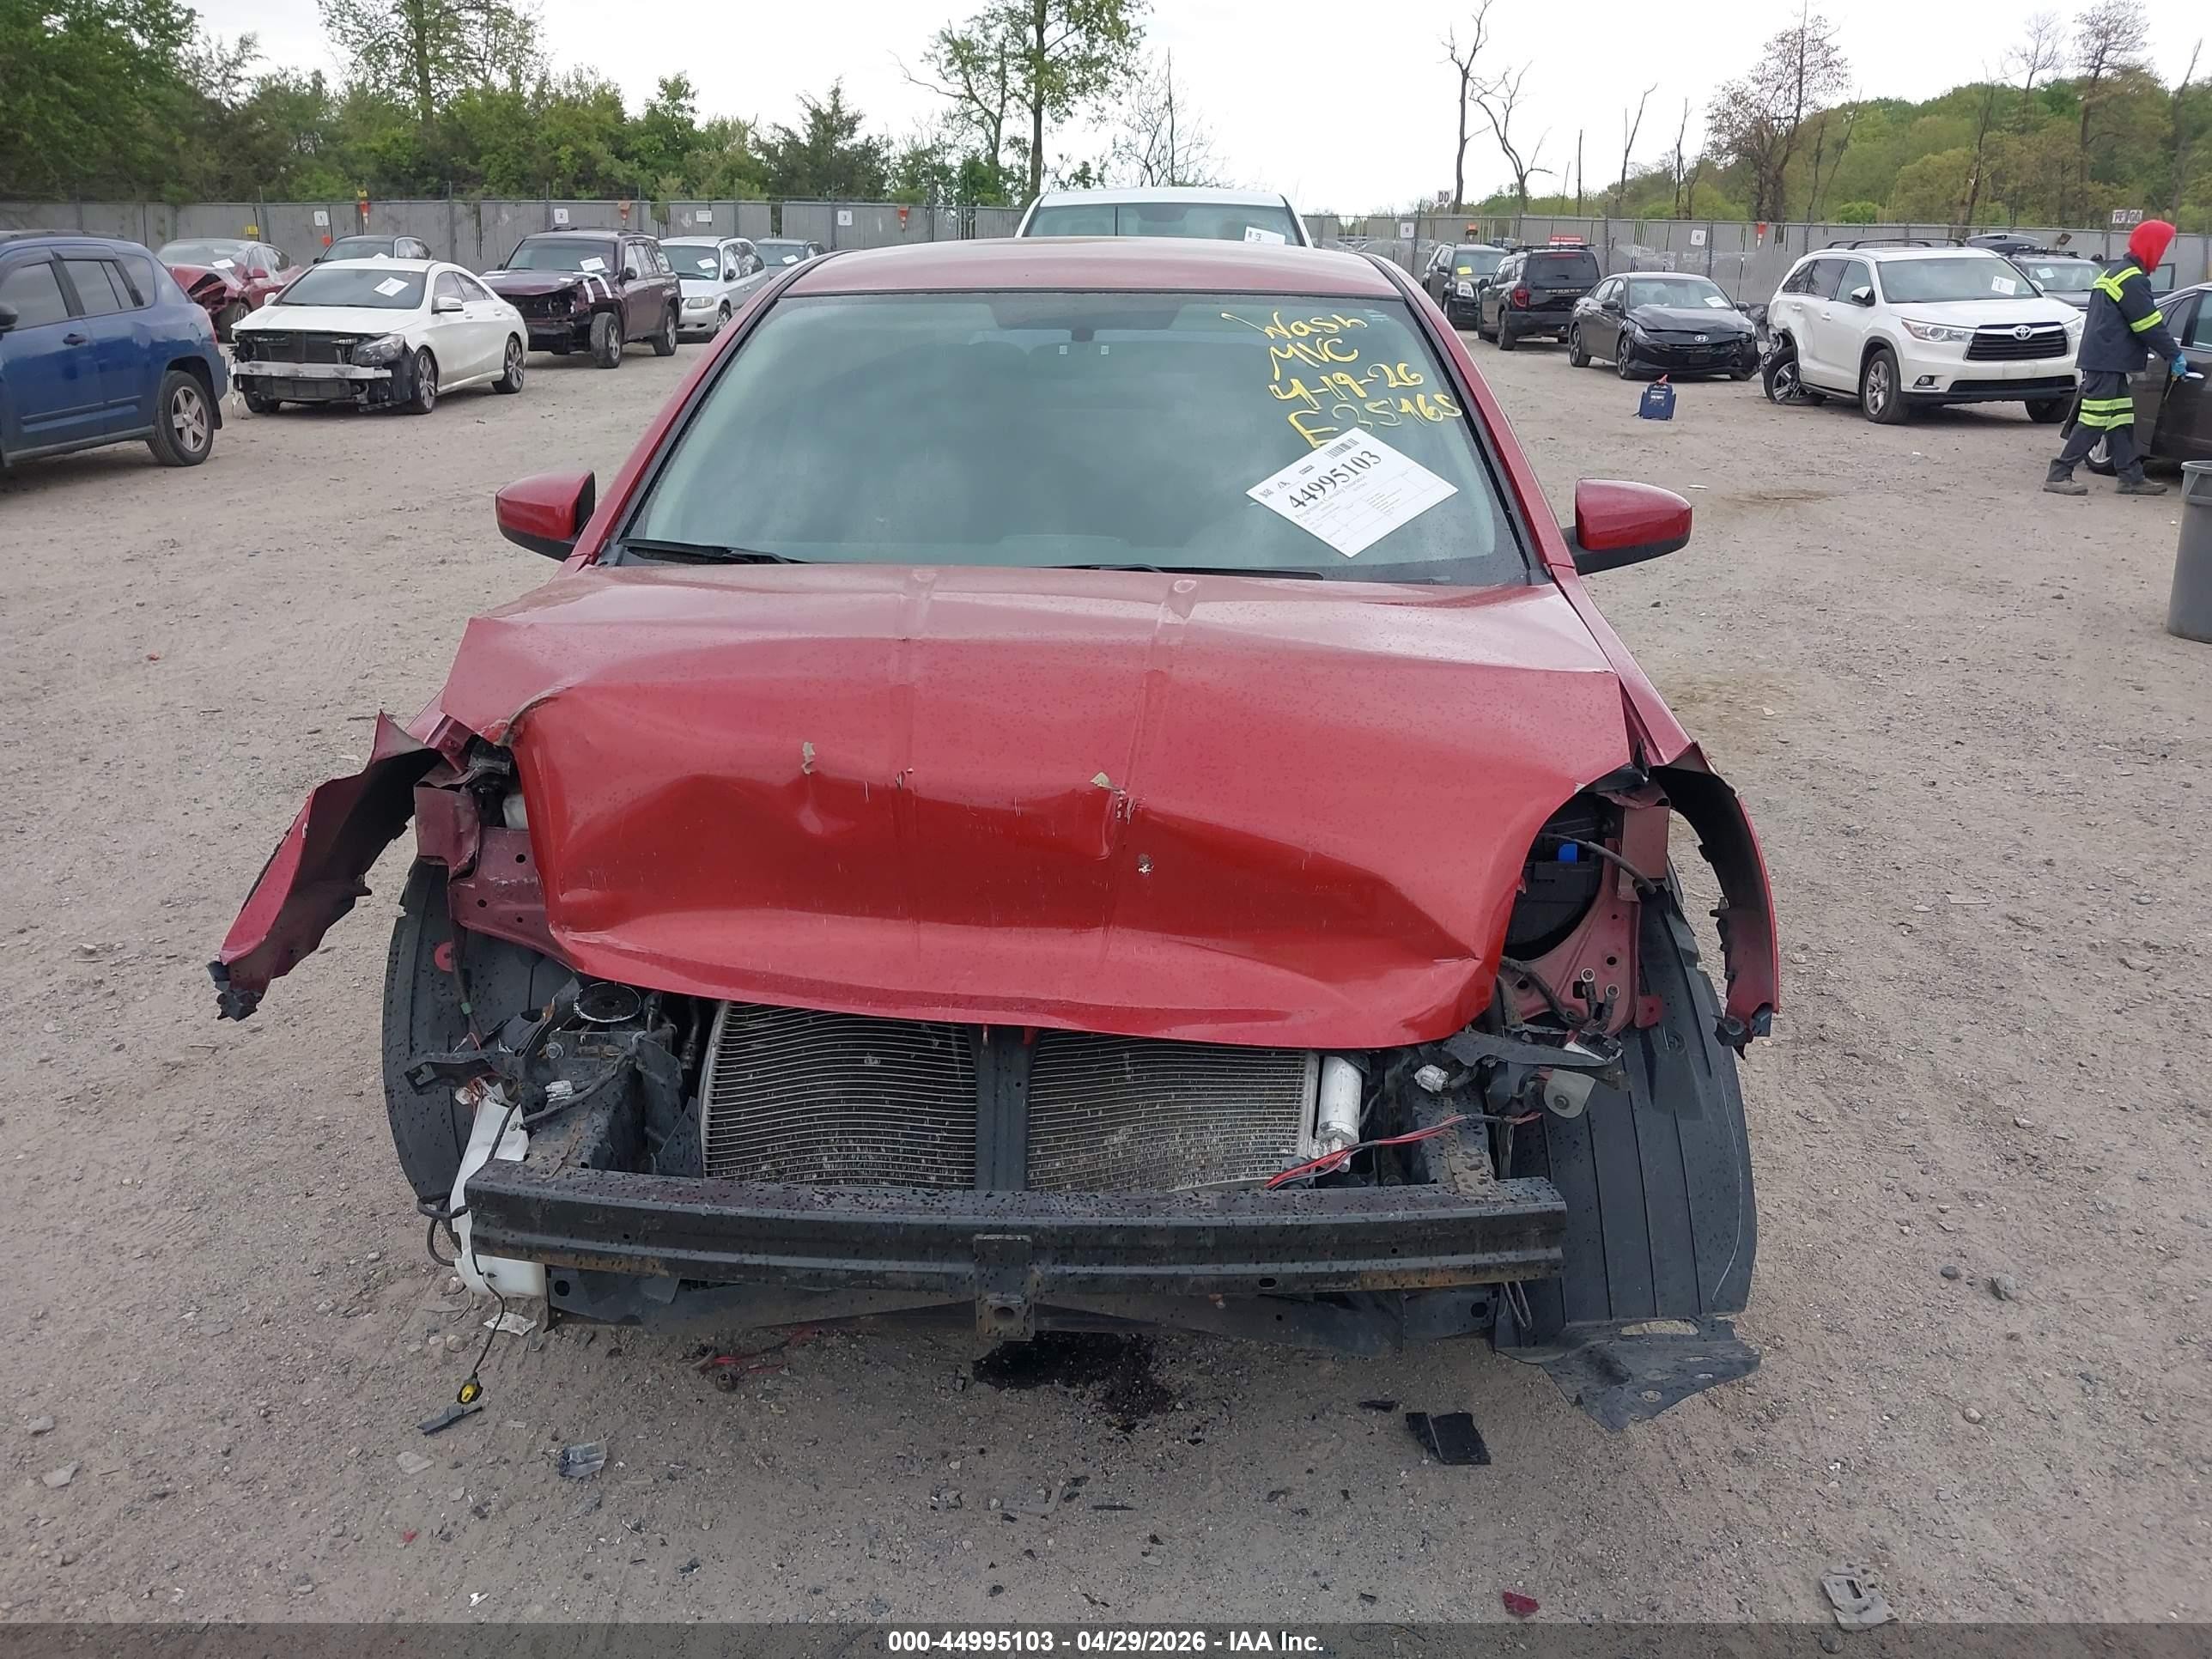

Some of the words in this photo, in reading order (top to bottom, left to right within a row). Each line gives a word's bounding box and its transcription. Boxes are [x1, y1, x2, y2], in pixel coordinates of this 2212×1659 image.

[1269, 337, 1358, 381] MVC
[1268, 362, 1425, 410] 4-19-26
[1289, 450, 1382, 508] 44995103
